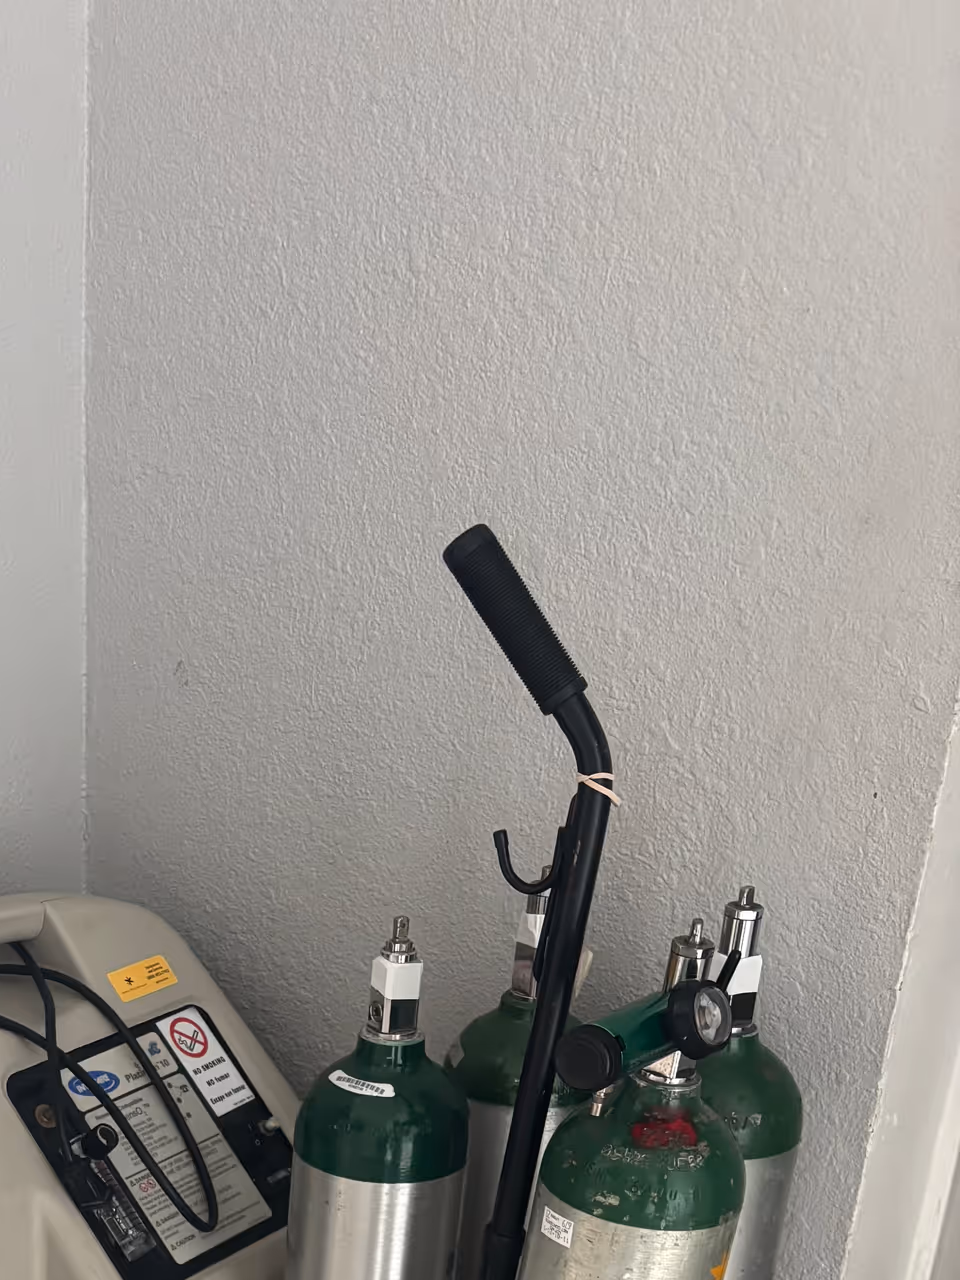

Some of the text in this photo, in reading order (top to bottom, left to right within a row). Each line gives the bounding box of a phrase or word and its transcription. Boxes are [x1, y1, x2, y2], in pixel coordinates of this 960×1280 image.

[192, 1056, 226, 1076] NO SMOKING
[206, 1072, 230, 1087] NO fumar
[175, 1233, 197, 1247] CAUTION
